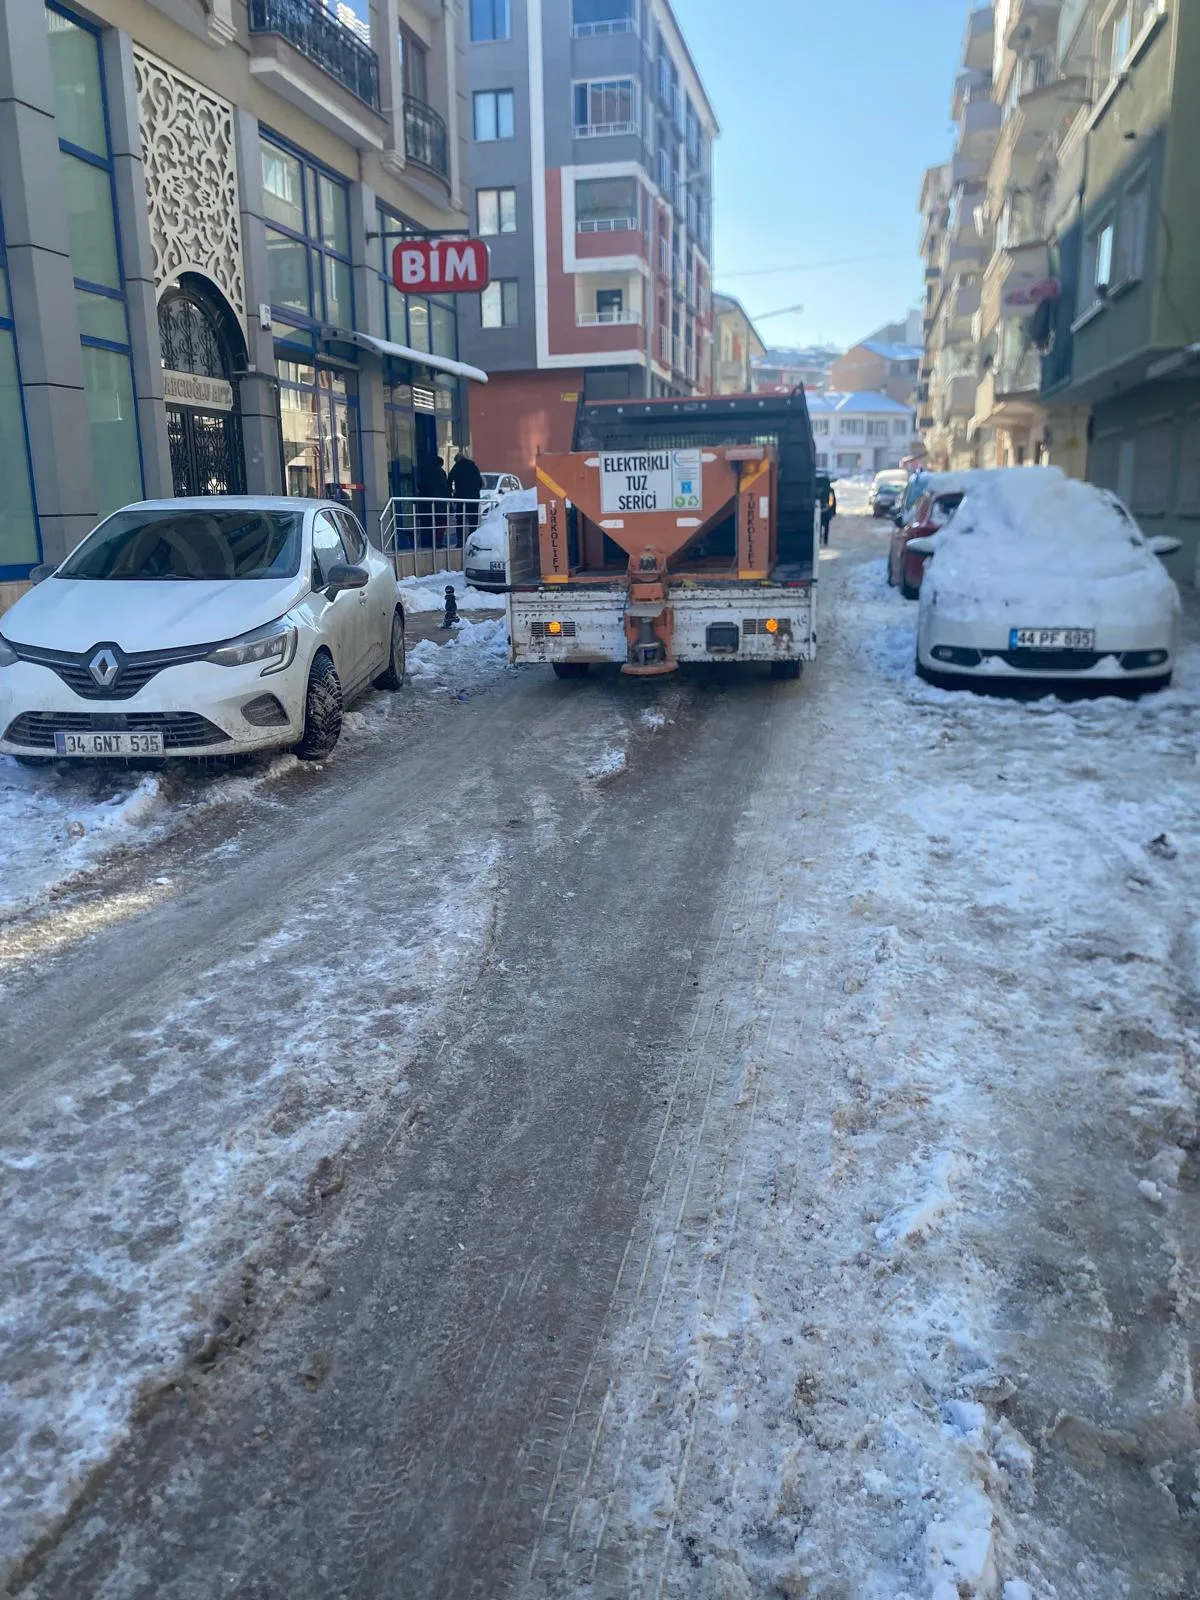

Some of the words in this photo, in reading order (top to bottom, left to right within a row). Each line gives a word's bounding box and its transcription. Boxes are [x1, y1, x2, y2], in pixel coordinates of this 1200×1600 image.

[401, 240, 477, 284] BİM
[604, 452, 669, 473] ELEKTRİKLİ
[625, 475, 648, 491] TUZ
[618, 491, 657, 510] SERİCİ
[1017, 631, 1034, 644] 44
[67, 736, 86, 753] 34
[93, 736, 121, 753] GNT
[130, 735, 159, 753] 535
